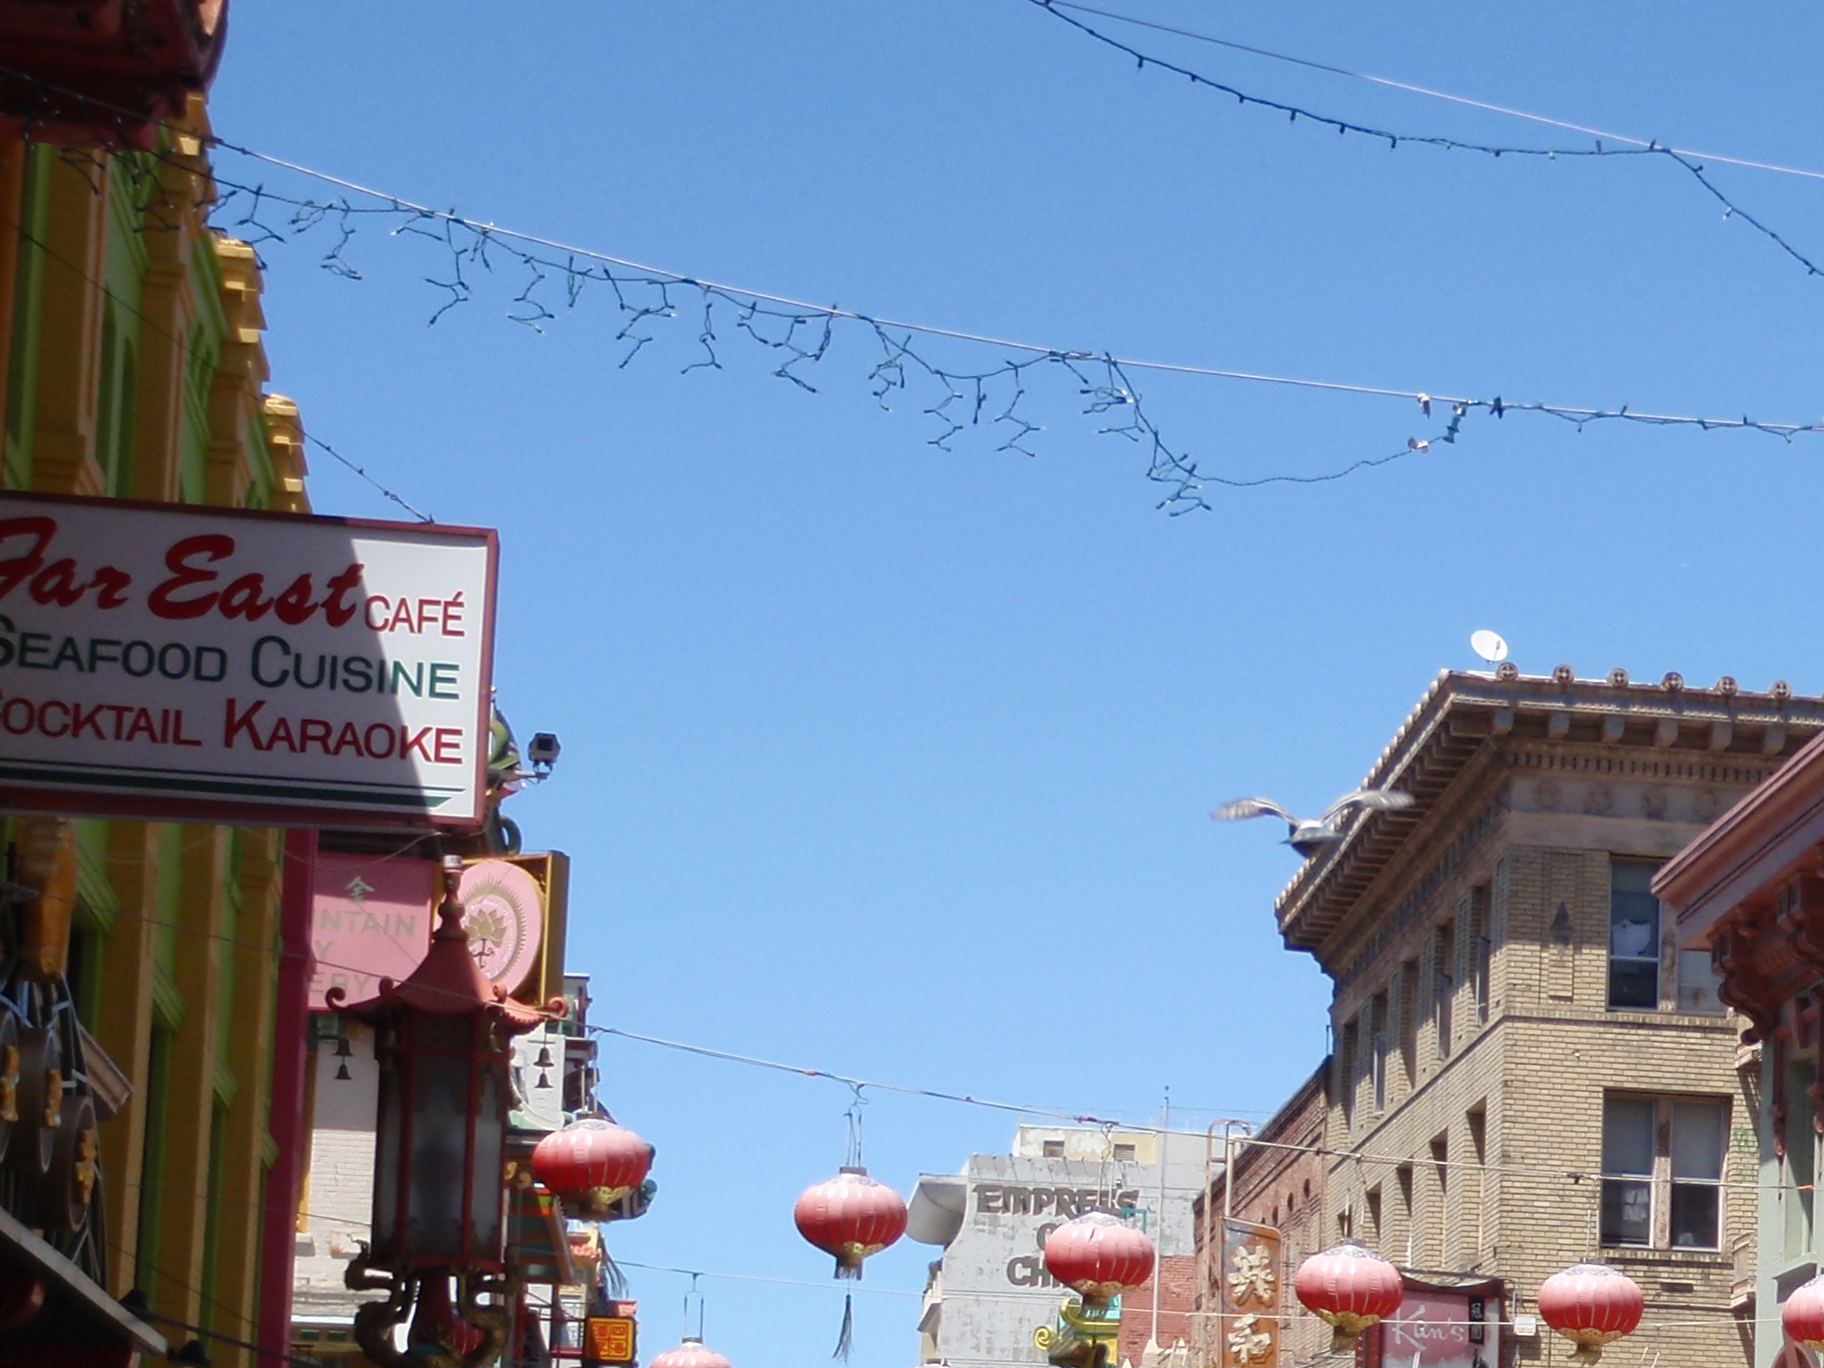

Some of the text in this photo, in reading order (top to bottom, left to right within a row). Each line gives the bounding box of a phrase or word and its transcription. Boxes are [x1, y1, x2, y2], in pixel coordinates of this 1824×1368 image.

[0, 515, 466, 638] Far East CAFÉ
[251, 635, 461, 700] CUISINE
[0, 690, 465, 765] OCKTAIL KARAOKE
